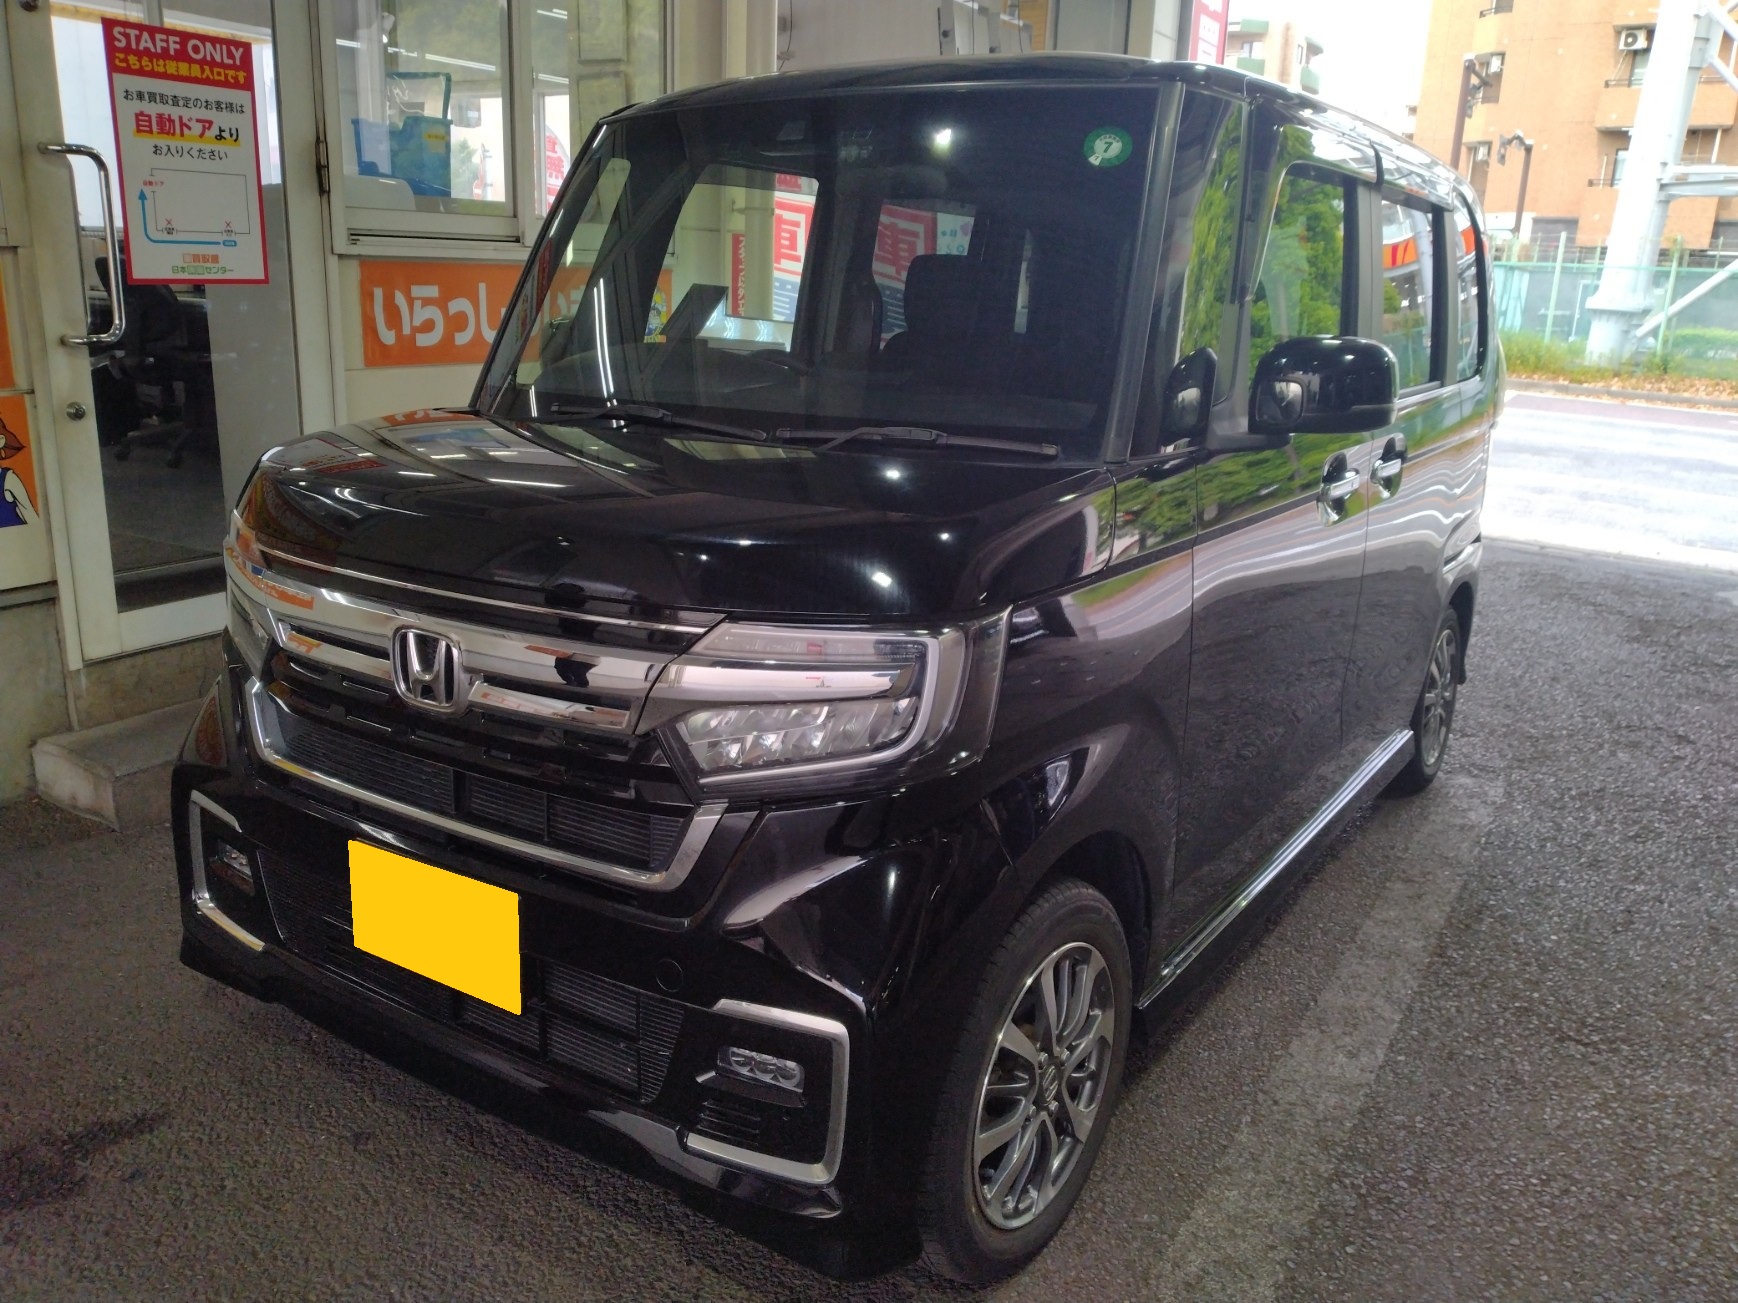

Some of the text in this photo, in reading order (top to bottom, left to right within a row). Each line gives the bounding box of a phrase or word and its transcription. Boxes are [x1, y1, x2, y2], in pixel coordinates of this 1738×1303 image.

[112, 26, 244, 66] STAFF ONLY
[114, 53, 247, 85] こちらは従業員入口です
[123, 89, 245, 114] お車買取査定のお客様は
[134, 110, 240, 143] 自動ドアより
[152, 144, 228, 162] お入りください
[1103, 141, 1114, 154] 7
[182, 253, 220, 265] 買取館
[171, 264, 234, 276] 日本センター
